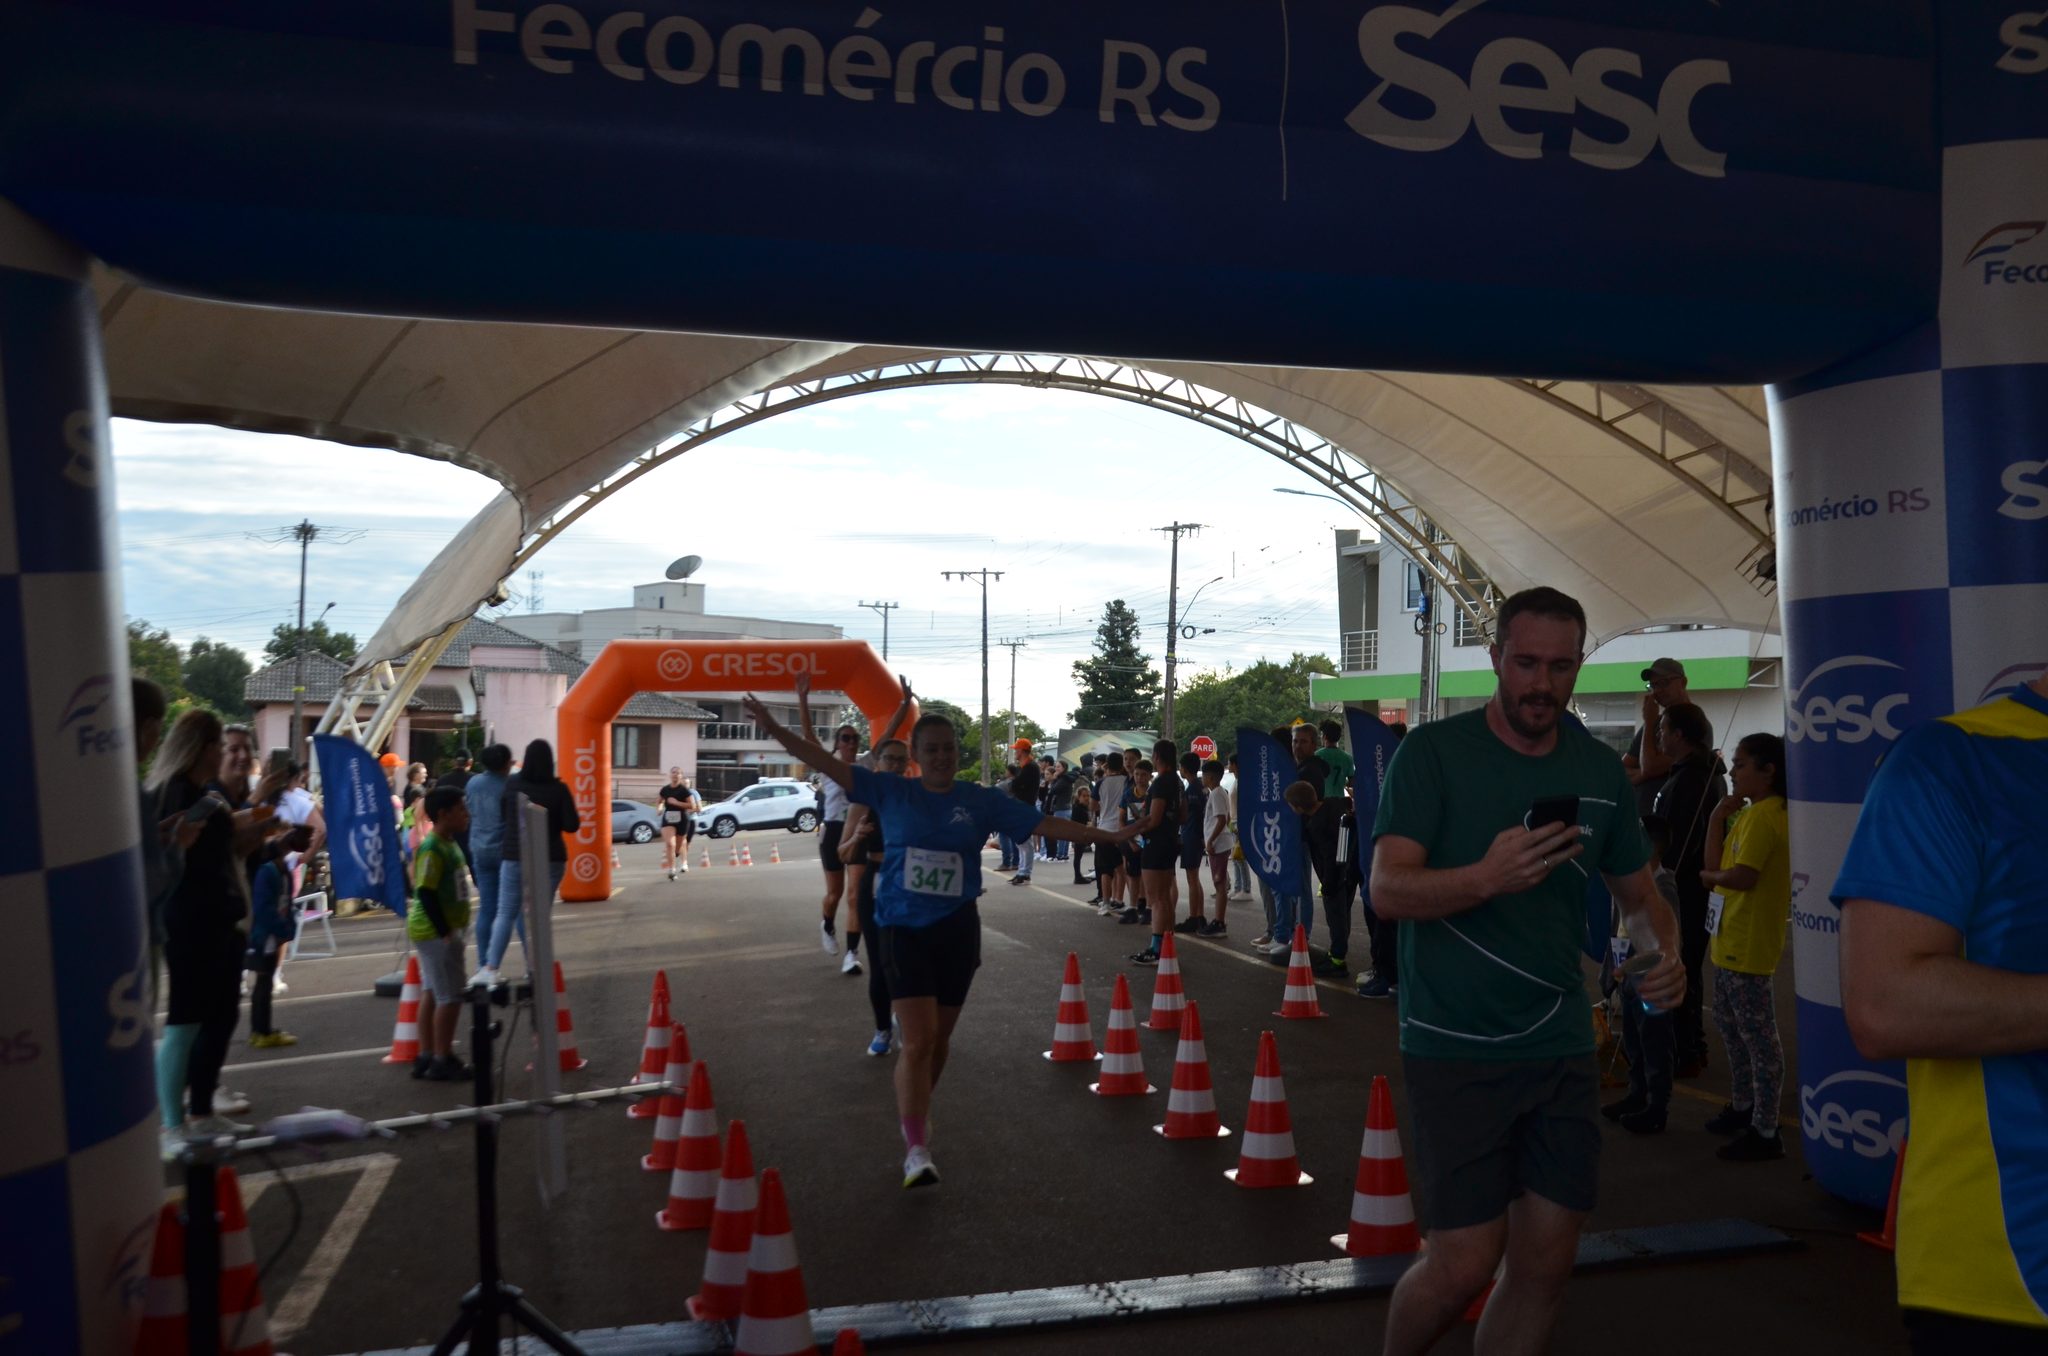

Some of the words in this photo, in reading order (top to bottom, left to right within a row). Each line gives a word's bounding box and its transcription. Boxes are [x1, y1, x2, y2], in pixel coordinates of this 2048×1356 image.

[452, 0, 1066, 118] Fecomércio
[1099, 38, 1222, 132] RS
[1344, 3, 1732, 178] Sesc
[1888, 487, 1931, 514] RS
[702, 651, 828, 677] CRESOL
[1192, 744, 1213, 752] PARE
[575, 738, 597, 844] CRESOL
[911, 865, 956, 892] 347
